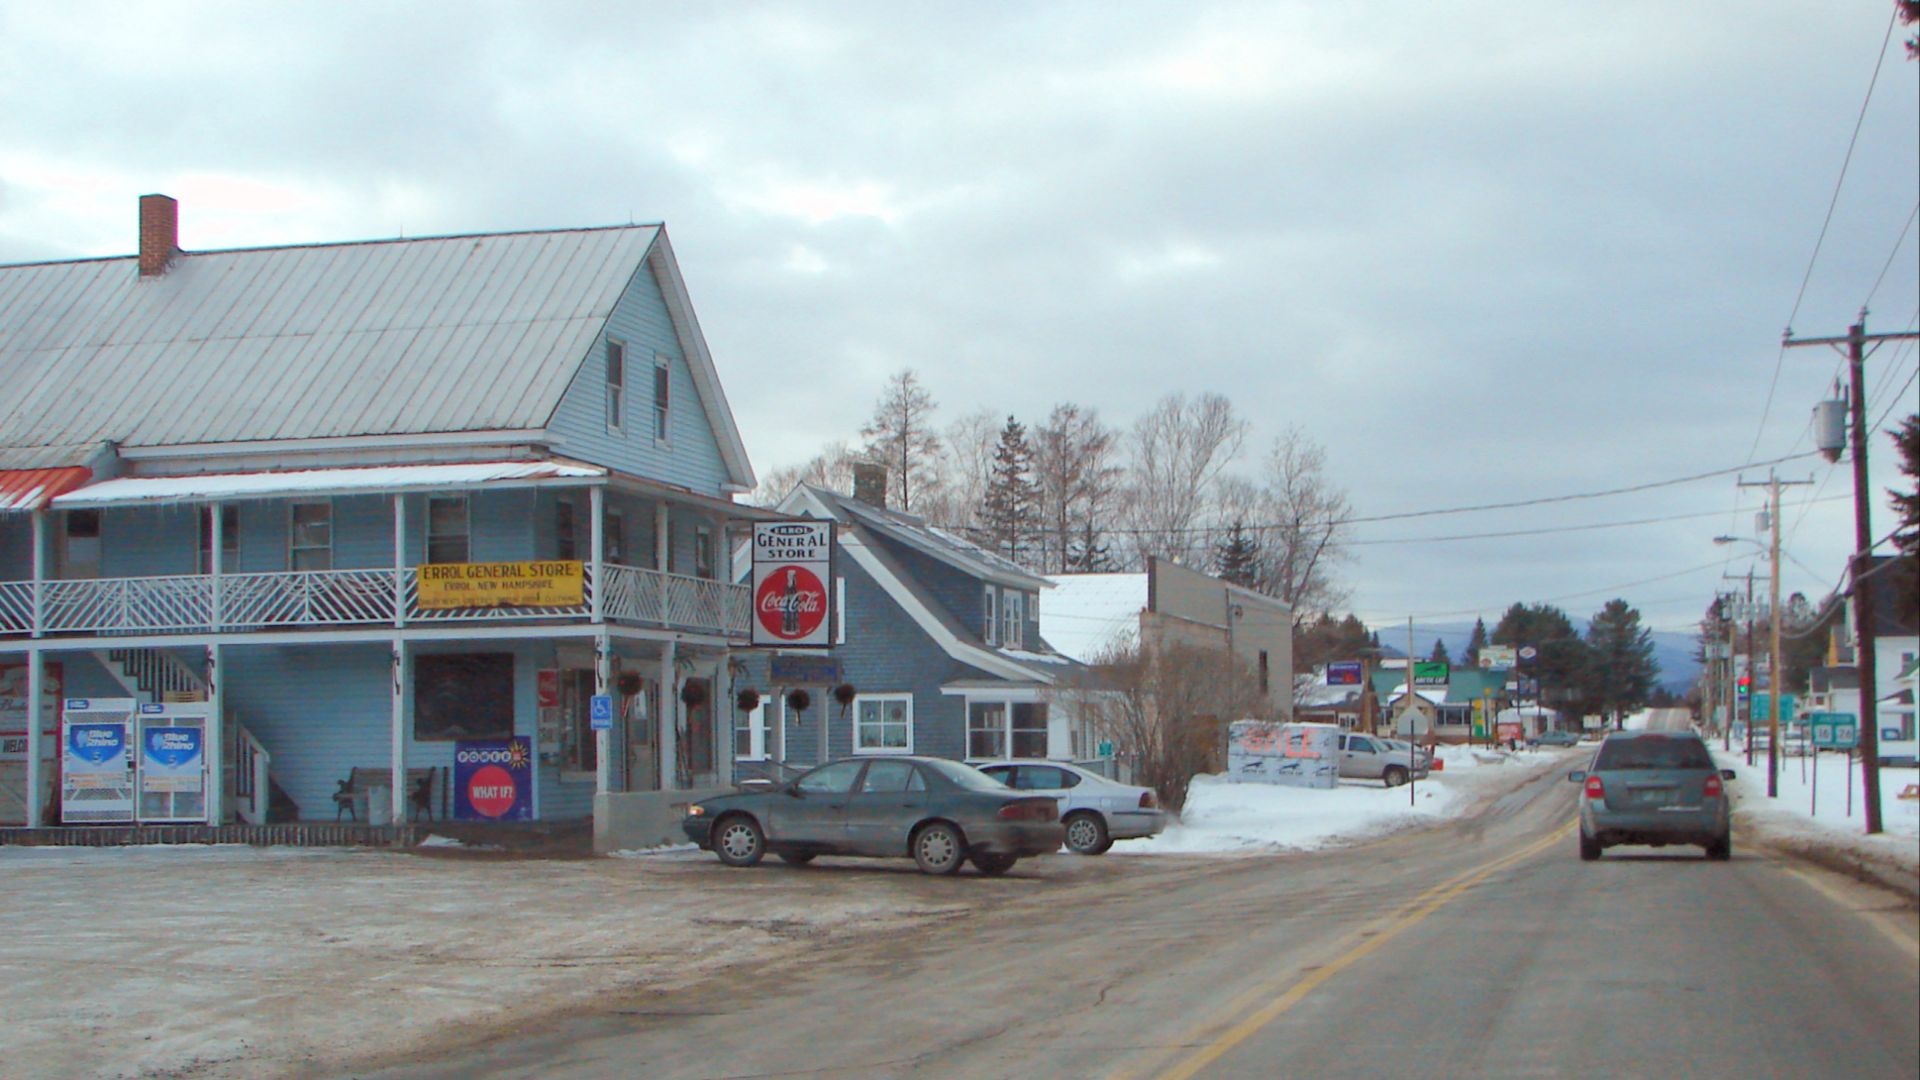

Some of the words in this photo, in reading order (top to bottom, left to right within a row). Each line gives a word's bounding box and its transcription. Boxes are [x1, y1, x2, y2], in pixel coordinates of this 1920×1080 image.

[757, 533, 828, 547] GENERAL
[768, 549, 816, 558] STORE
[423, 566, 464, 580] ERROL
[466, 564, 525, 578] GENERAL
[529, 563, 574, 577] STORE
[478, 581, 497, 590] NEW
[502, 579, 553, 589] HAMPSHIRE
[1240, 726, 1321, 758] SALE
[473, 786, 498, 799] WHAT
[500, 786, 513, 798] IF?
